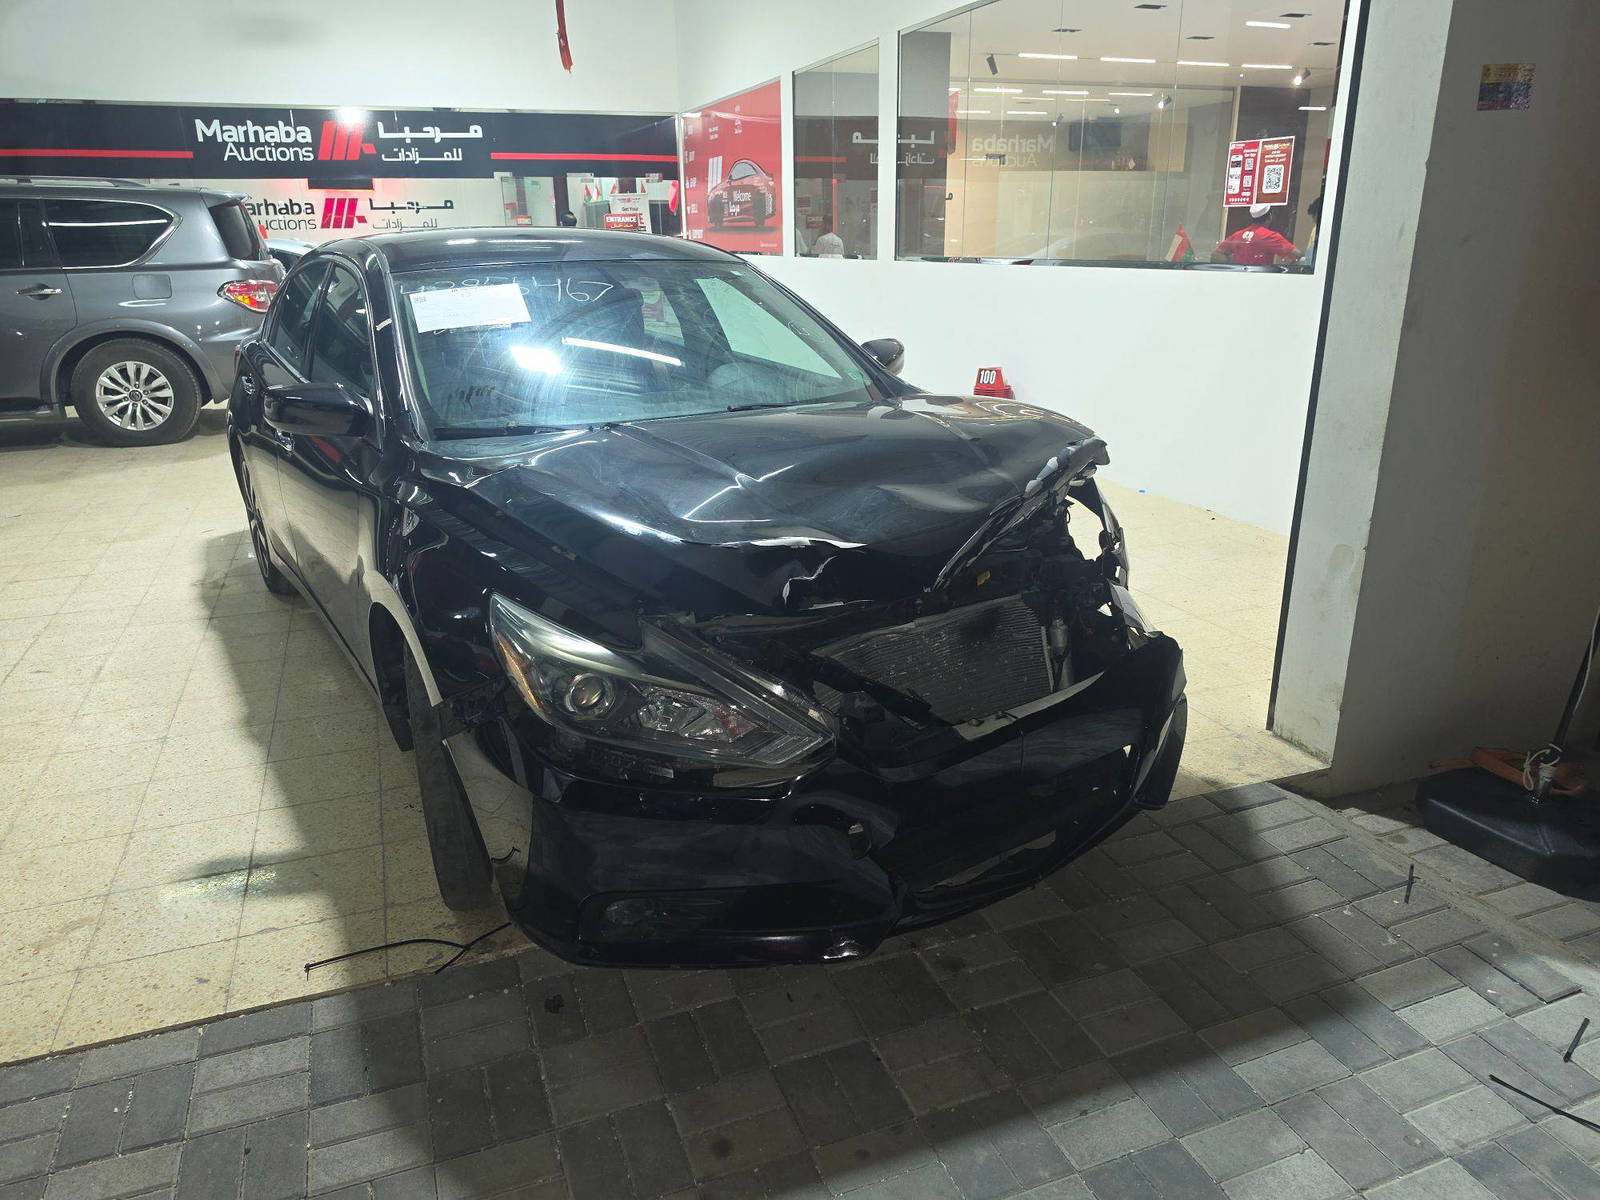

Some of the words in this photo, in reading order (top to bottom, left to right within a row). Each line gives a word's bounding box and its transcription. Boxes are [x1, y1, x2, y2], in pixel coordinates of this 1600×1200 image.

[194, 119, 313, 142] Marhaba
[377, 121, 483, 143] مرحبا
[223, 142, 315, 161] Auctions
[381, 147, 463, 164] للمزادات
[246, 198, 316, 216] arhaba
[258, 215, 317, 231] uctions
[606, 215, 637, 223] ENTRANCE
[980, 370, 996, 384] 100
